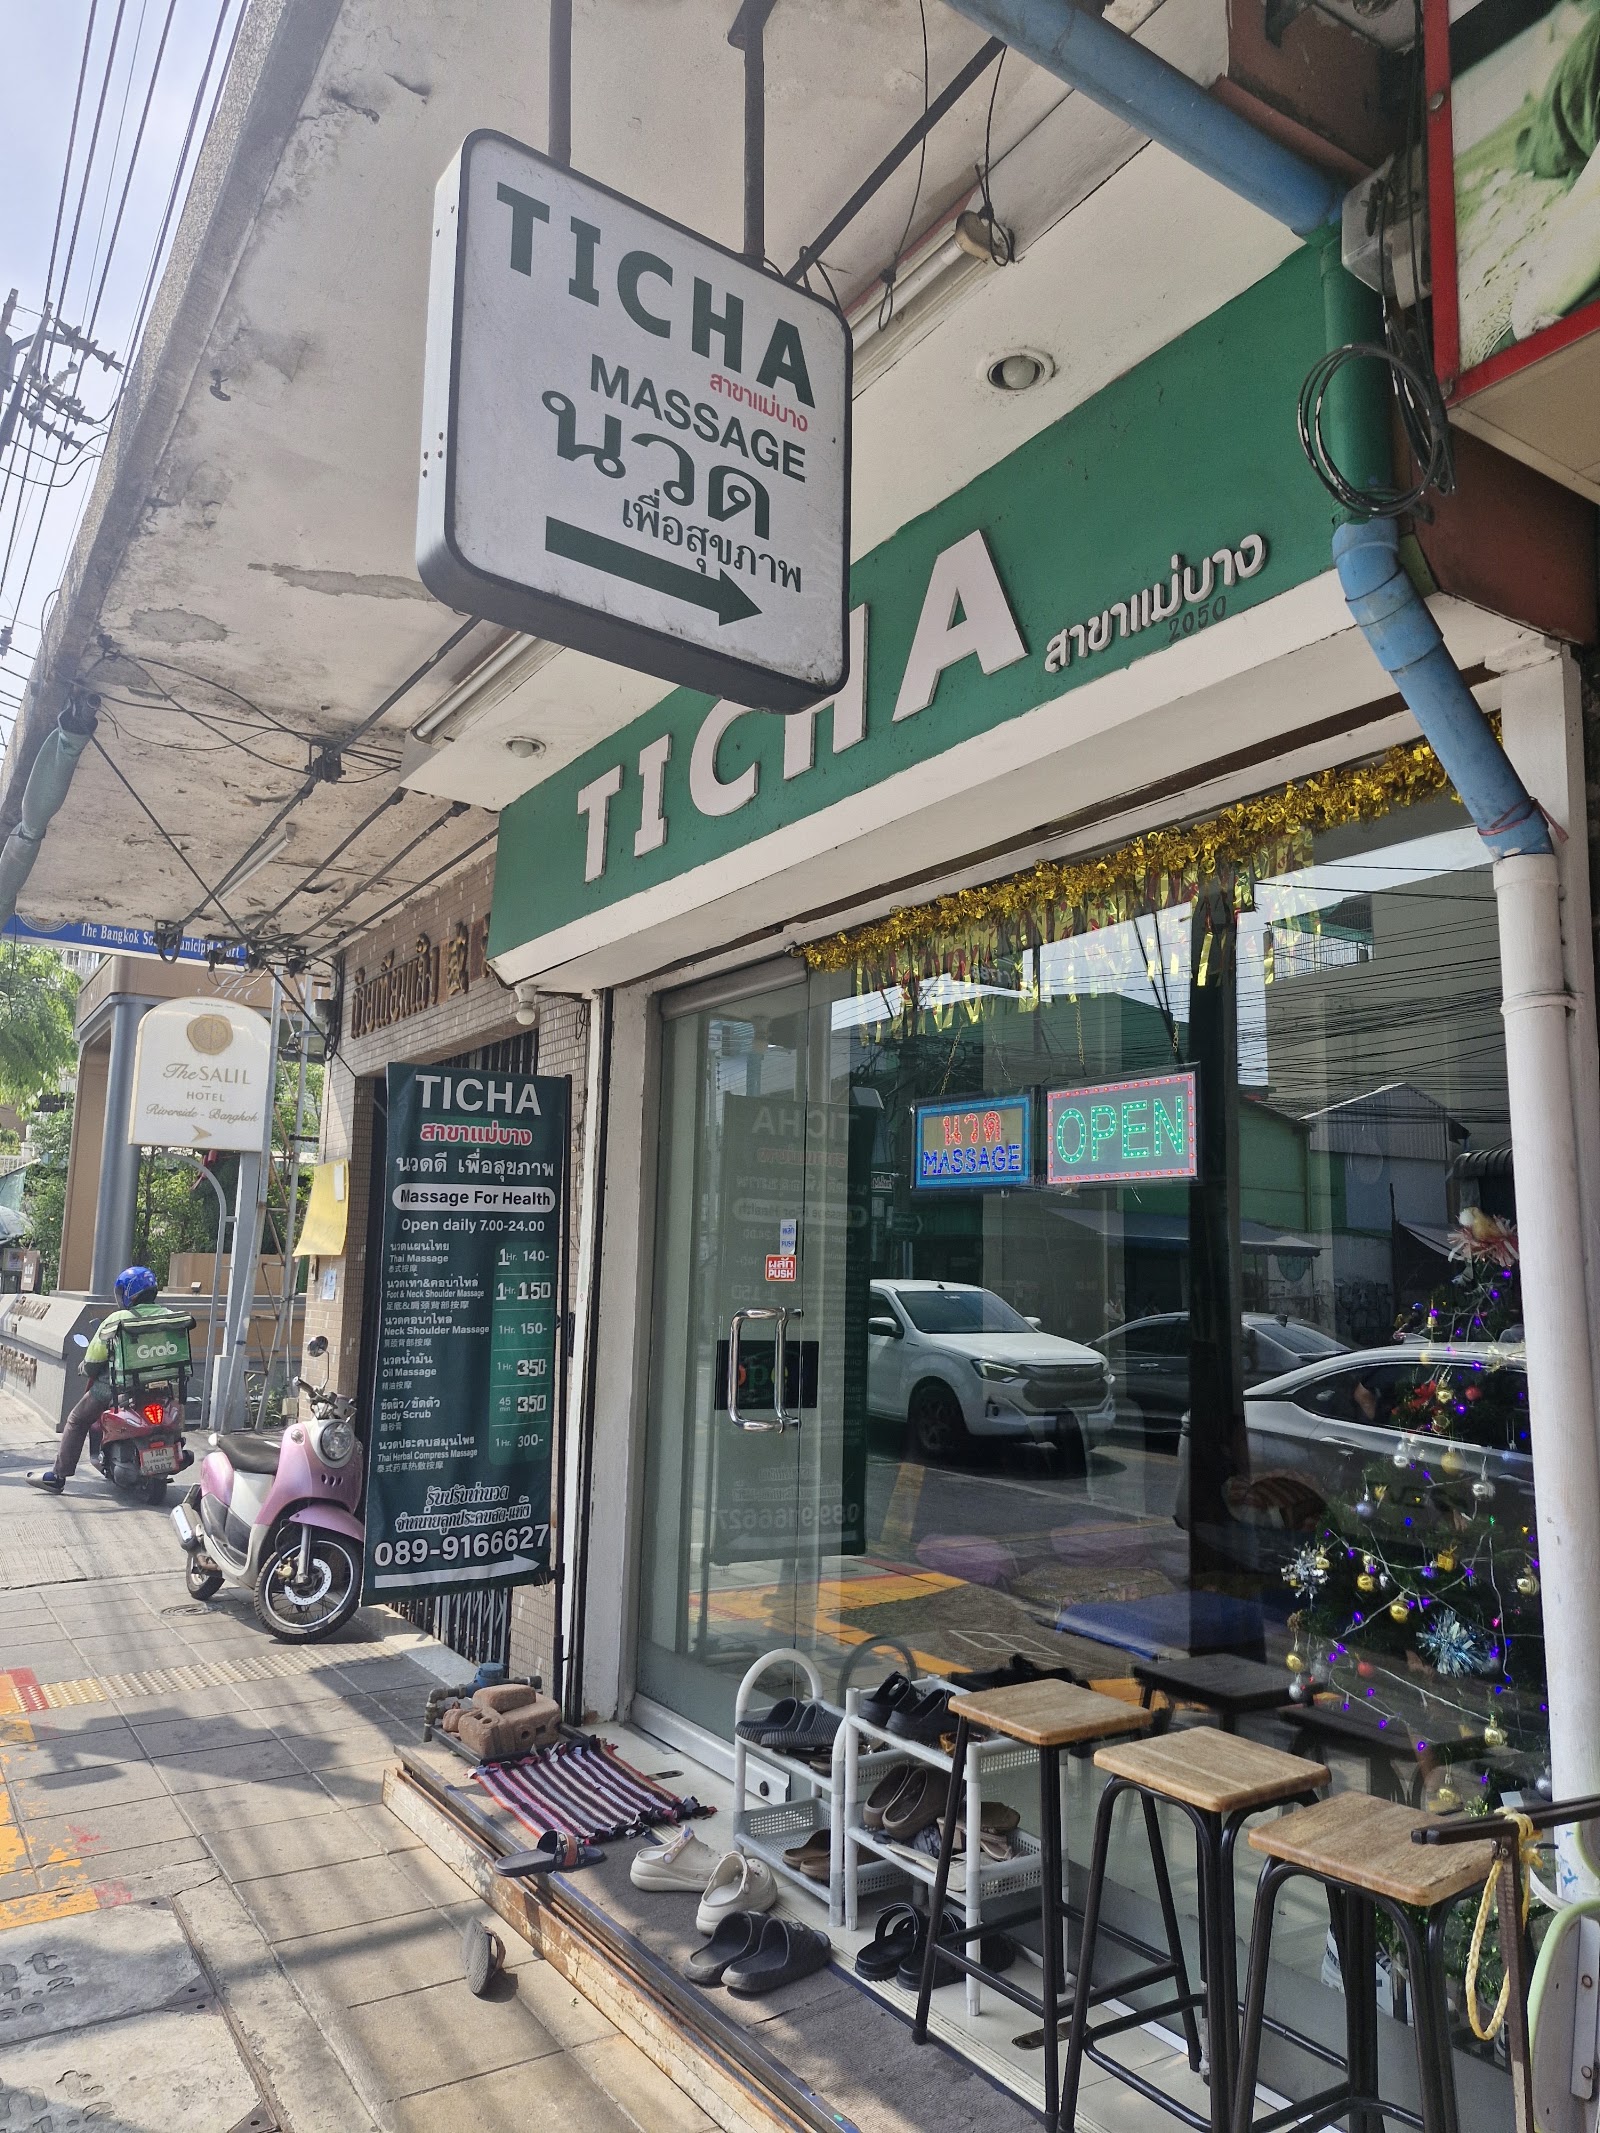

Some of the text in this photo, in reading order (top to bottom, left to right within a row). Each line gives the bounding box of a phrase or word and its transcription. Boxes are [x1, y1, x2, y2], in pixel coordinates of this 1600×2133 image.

[496, 181, 815, 409] TICHA
[709, 371, 809, 433] สาขาแม่บาง
[590, 353, 806, 483] MASSAGE
[541, 388, 771, 541] นวด
[622, 489, 802, 594] เพื่อสุขภาพ
[1044, 533, 1266, 673] สาขาแม่บาง
[1168, 595, 1228, 643] 2050
[577, 529, 1028, 882] TICHA
[81, 922, 98, 938] The
[100, 925, 140, 945] Bangkok
[162, 1062, 252, 1085] The SALIL
[186, 1091, 225, 1102] HOTEL
[415, 1074, 542, 1116] TICHA
[145, 1103, 198, 1118] Riverside
[208, 1108, 259, 1124] Bangkok
[420, 1120, 533, 1145] สาขาแม่บาง
[942, 1110, 1001, 1145] นวด
[1056, 1095, 1185, 1165] OPEN
[396, 1148, 554, 1182] นวดดี เพื่อสุขภาพ
[922, 1143, 1022, 1176] MASSAGE
[400, 1189, 551, 1206] Massage For Health
[401, 1218, 545, 1233] Open daily 7.00-24.00
[389, 1239, 450, 1251] นวดแผนไทย
[389, 1254, 449, 1264] Thai Massage
[768, 1256, 794, 1269] ผลัก
[768, 1269, 794, 1279] PUSH
[386, 1290, 399, 1298] Foot
[406, 1289, 424, 1298] Neck
[425, 1289, 455, 1298] Shoulder
[457, 1289, 485, 1299] Massage
[384, 1325, 490, 1335] Neck Shoulder Massage
[136, 1341, 178, 1359] Grab
[382, 1368, 437, 1378] Oil Massage
[380, 1409, 432, 1421] Body Scrub
[498, 1394, 547, 1413] 45 350
[377, 1448, 478, 1462] Thai Herbal Compress Massage
[374, 1523, 550, 1567] 089-9166627
